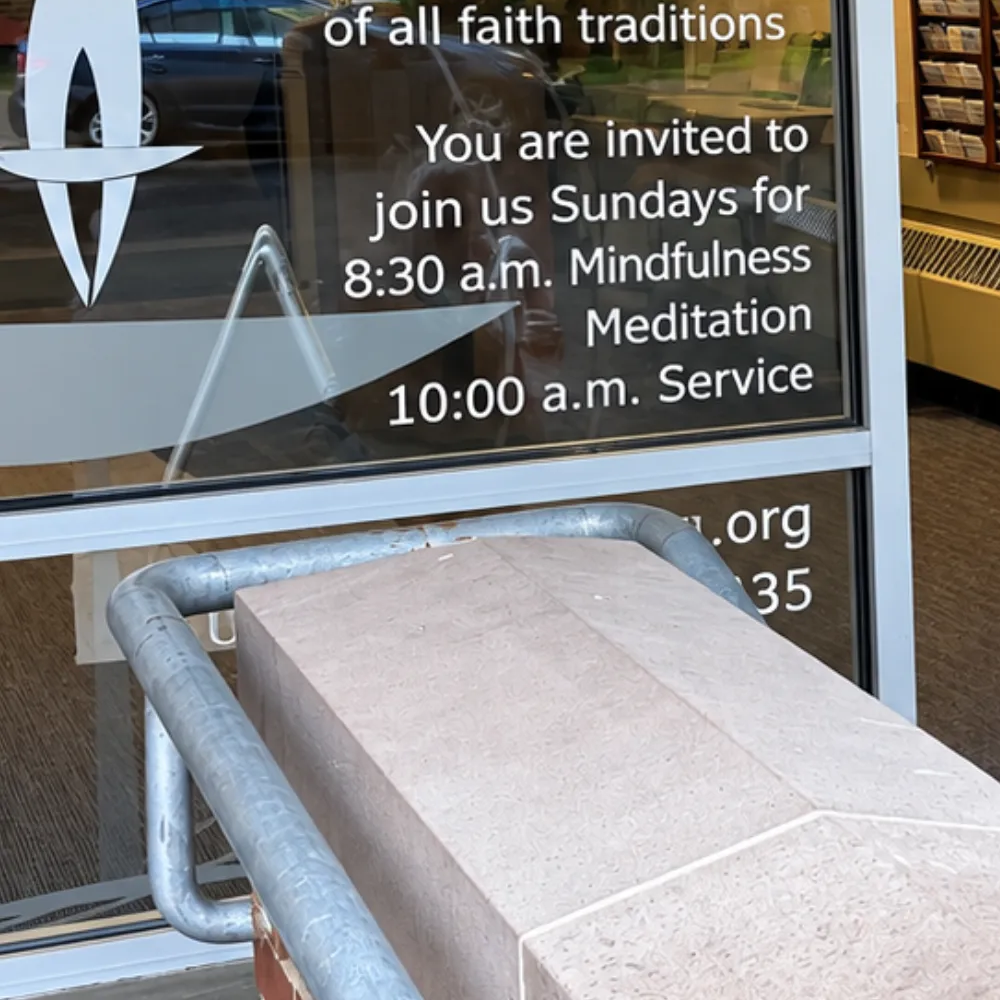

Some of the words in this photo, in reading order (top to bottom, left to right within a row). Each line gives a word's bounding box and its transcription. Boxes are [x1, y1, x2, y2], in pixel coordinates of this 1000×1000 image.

[324, 5, 374, 47] of
[389, 5, 441, 46] all
[457, 5, 561, 45] faith
[577, 3, 785, 43] traditions
[415, 123, 501, 163] You
[519, 129, 590, 160] are
[606, 114, 751, 158] invited
[765, 119, 808, 153] to
[368, 190, 461, 243] join
[481, 195, 534, 226] us
[551, 179, 738, 227] Sundays
[751, 175, 811, 214] for
[344, 254, 444, 299] 8:30
[460, 259, 552, 292] a.m.
[571, 239, 811, 286] Mindfulness
[587, 298, 811, 347] Meditation
[389, 376, 525, 426] 10:00
[542, 377, 639, 412] a.m.
[659, 357, 813, 403] Service
[682, 503, 811, 549] .org
[735, 567, 812, 615] 35
